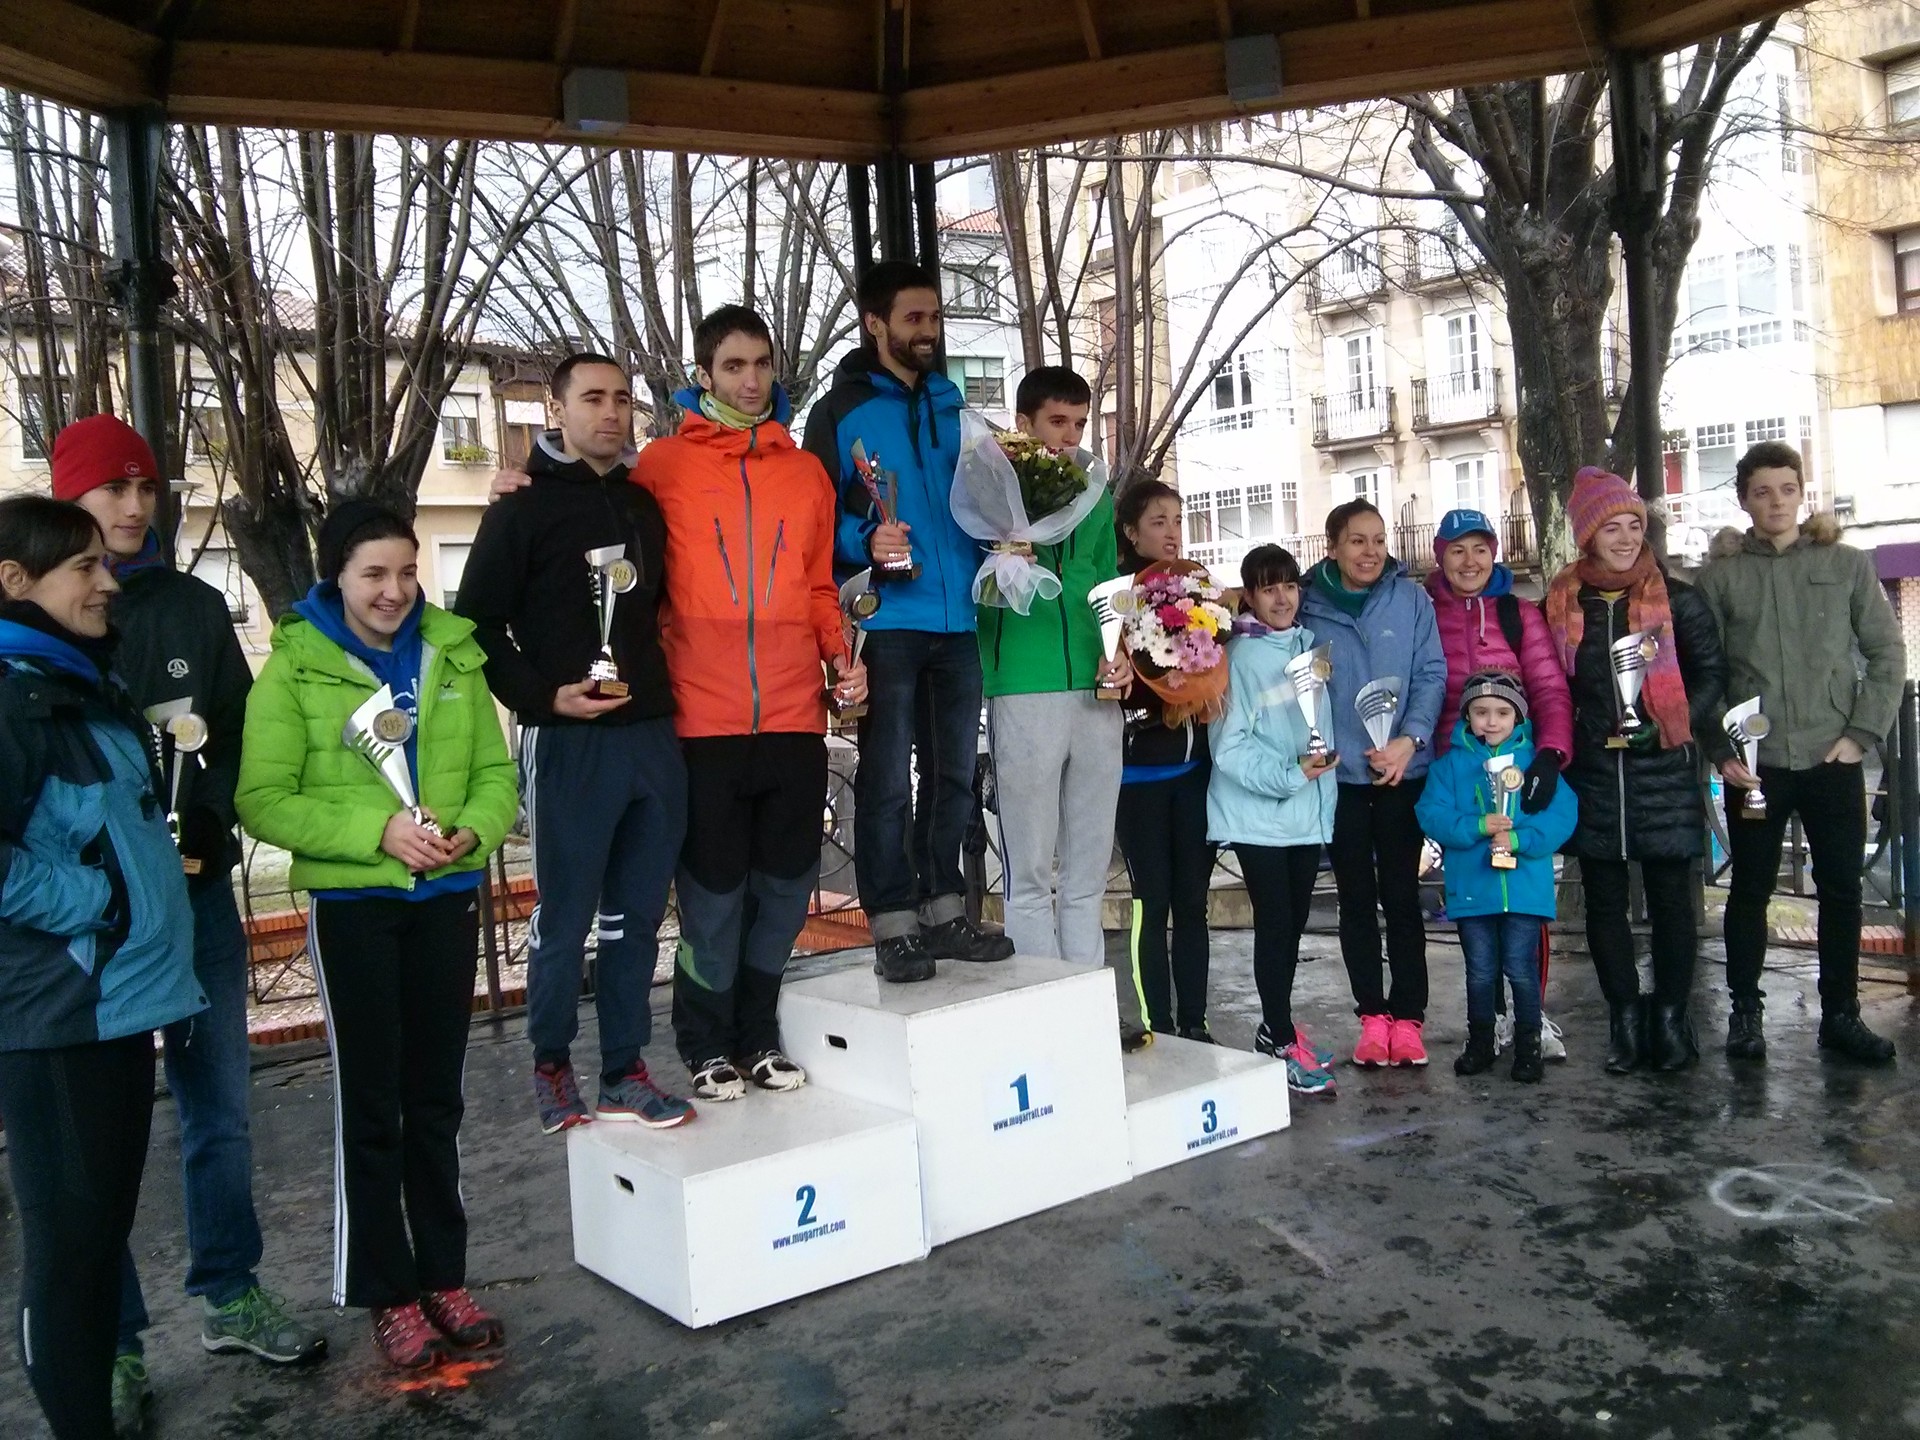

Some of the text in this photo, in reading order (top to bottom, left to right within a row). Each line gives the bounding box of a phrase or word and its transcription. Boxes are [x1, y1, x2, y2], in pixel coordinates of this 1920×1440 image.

[1010, 1073, 1030, 1112] 1
[1202, 1099, 1218, 1133] 3
[796, 1184, 817, 1227] 2
